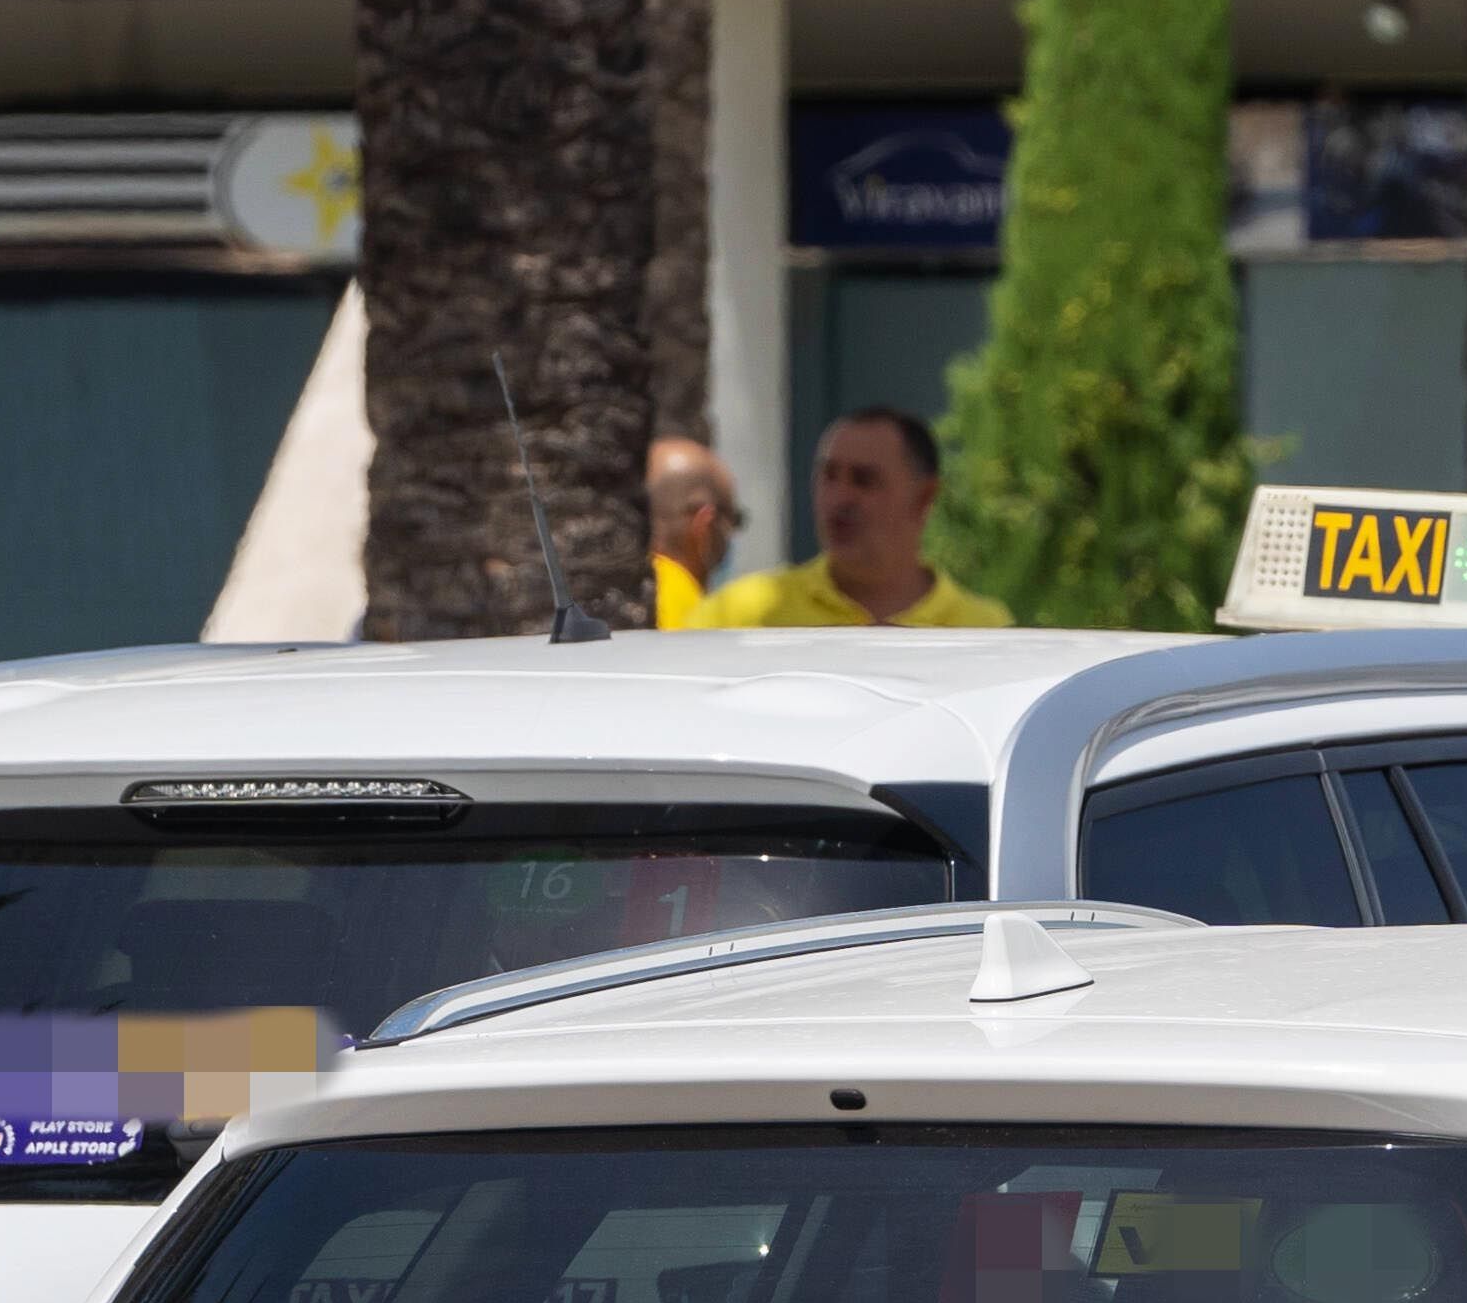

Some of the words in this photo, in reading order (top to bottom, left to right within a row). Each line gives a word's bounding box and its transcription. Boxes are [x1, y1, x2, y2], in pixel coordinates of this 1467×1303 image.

[1314, 511, 1447, 595] TAXI
[520, 861, 575, 899] 16
[30, 1121, 64, 1134] PLAY
[68, 1121, 113, 1134] STORE
[25, 1142, 67, 1154] APPLE
[69, 1142, 115, 1154] STORE
